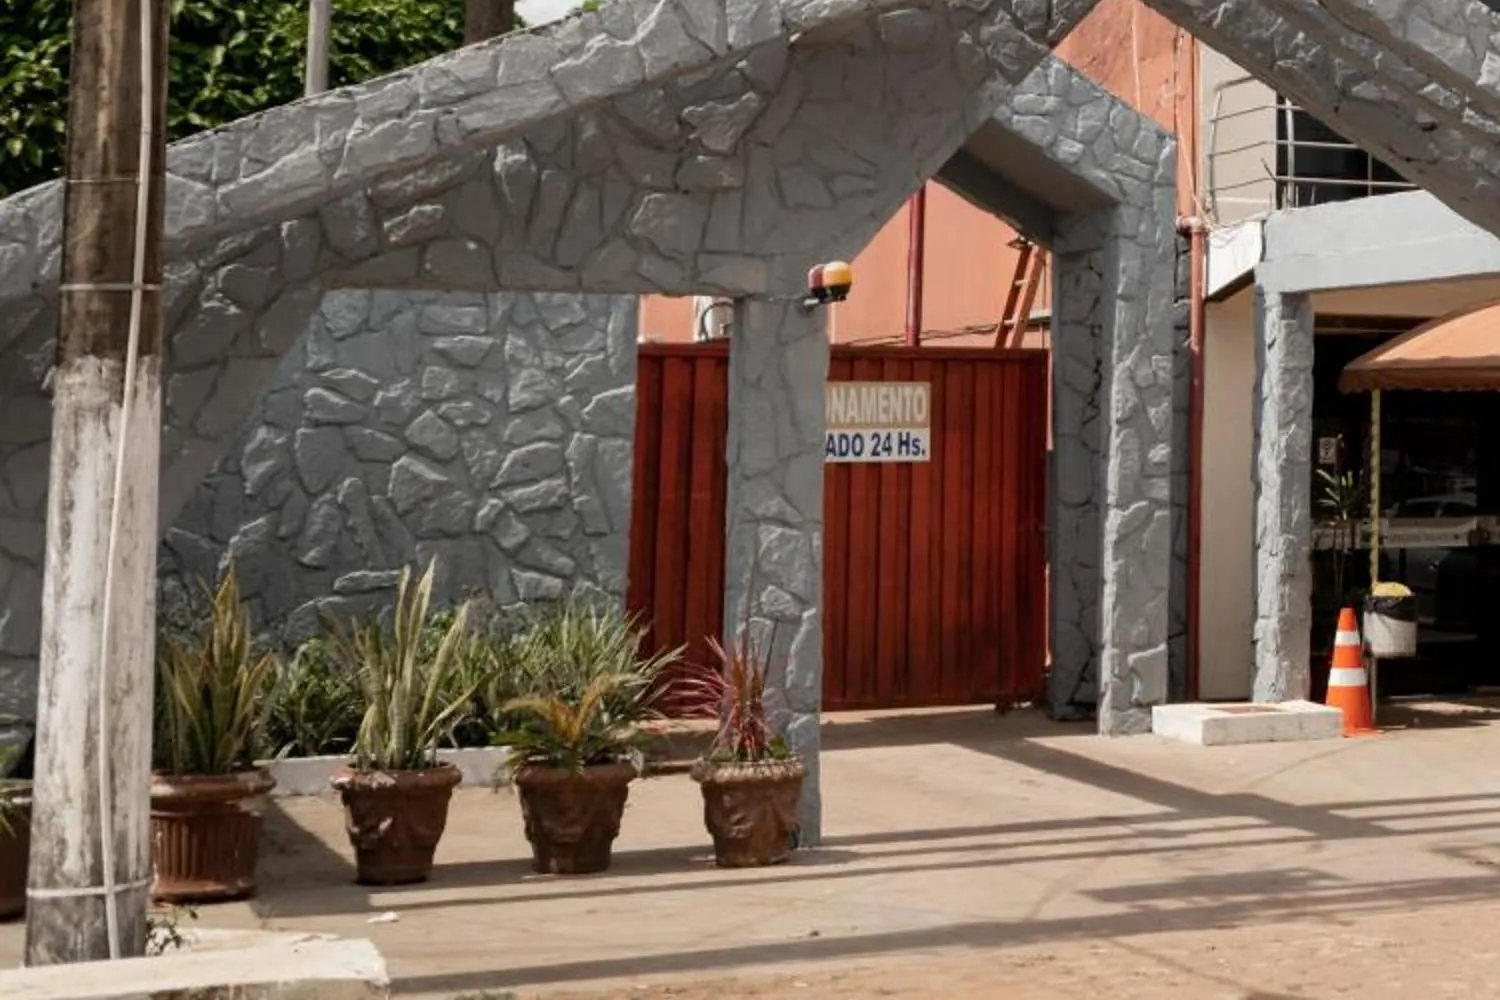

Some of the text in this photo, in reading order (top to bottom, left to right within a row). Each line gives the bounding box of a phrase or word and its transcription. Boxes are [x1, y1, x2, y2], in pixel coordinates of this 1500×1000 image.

[826, 385, 927, 424] NAMENTO
[870, 432, 893, 457] 24
[897, 432, 926, 457] Hs.
